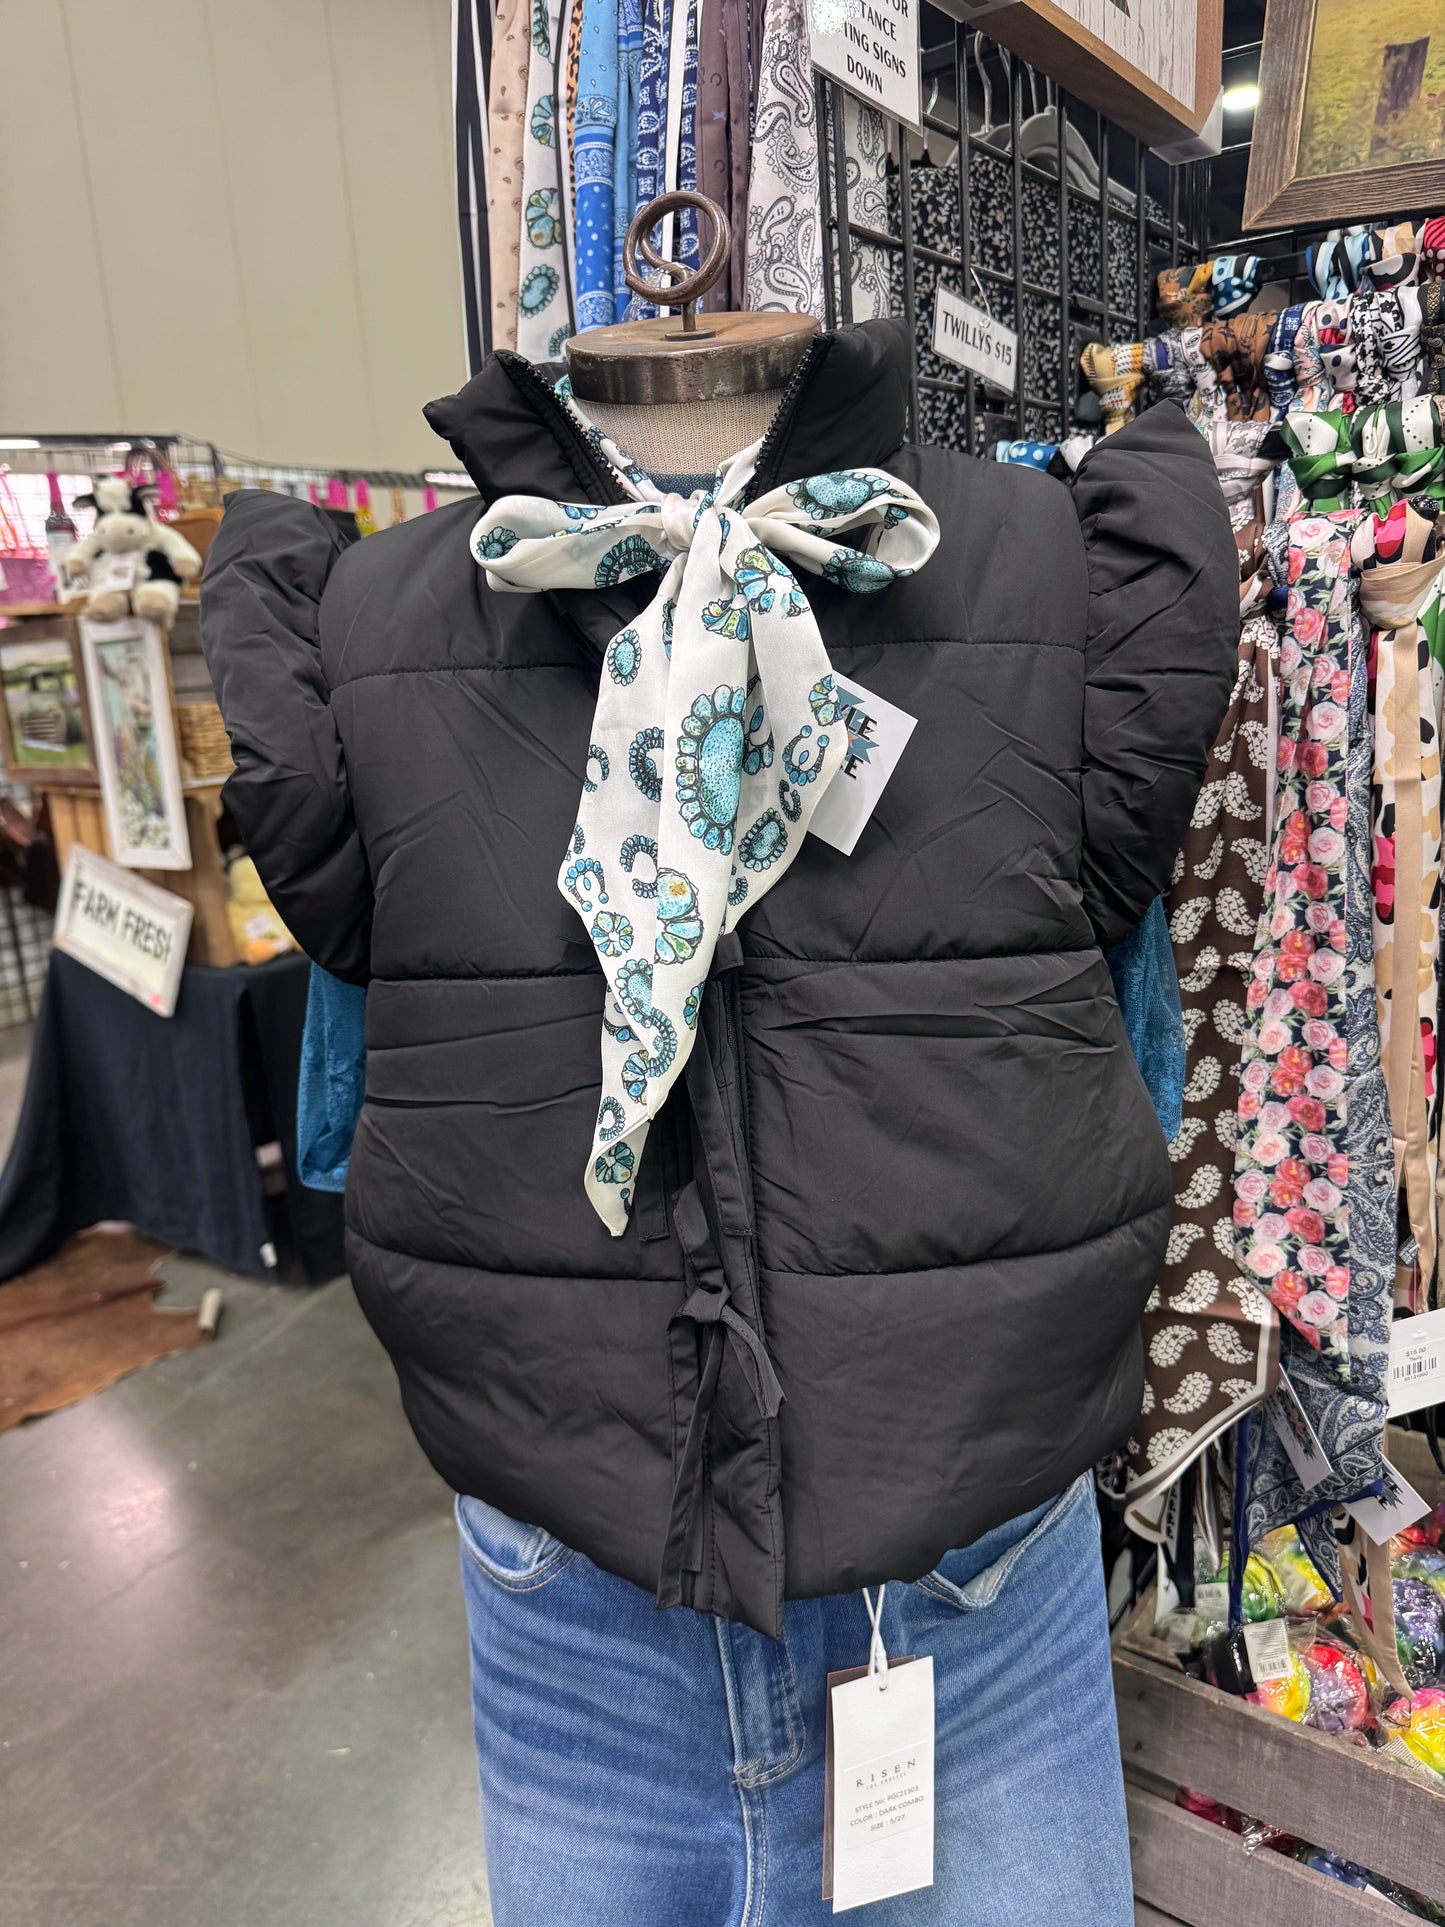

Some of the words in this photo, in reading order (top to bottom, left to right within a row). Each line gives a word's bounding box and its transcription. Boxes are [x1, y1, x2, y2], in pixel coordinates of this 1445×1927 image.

[860, 0, 897, 41] TANCE
[886, 0, 909, 18] OR
[844, 21, 870, 53] TING
[873, 42, 906, 78] SIGNS
[847, 54, 883, 94] DOWN
[943, 310, 991, 355] TWILLYS
[995, 340, 1012, 366] $15
[71, 881, 121, 935] FARM
[856, 1758, 916, 1788] RISEN
[849, 1814, 873, 1826] COLOR
[879, 1805, 897, 1816] DARK
[898, 1795, 925, 1809] COMBO
[855, 1802, 873, 1813] STYLE
[870, 1822, 884, 1831] SIZE
